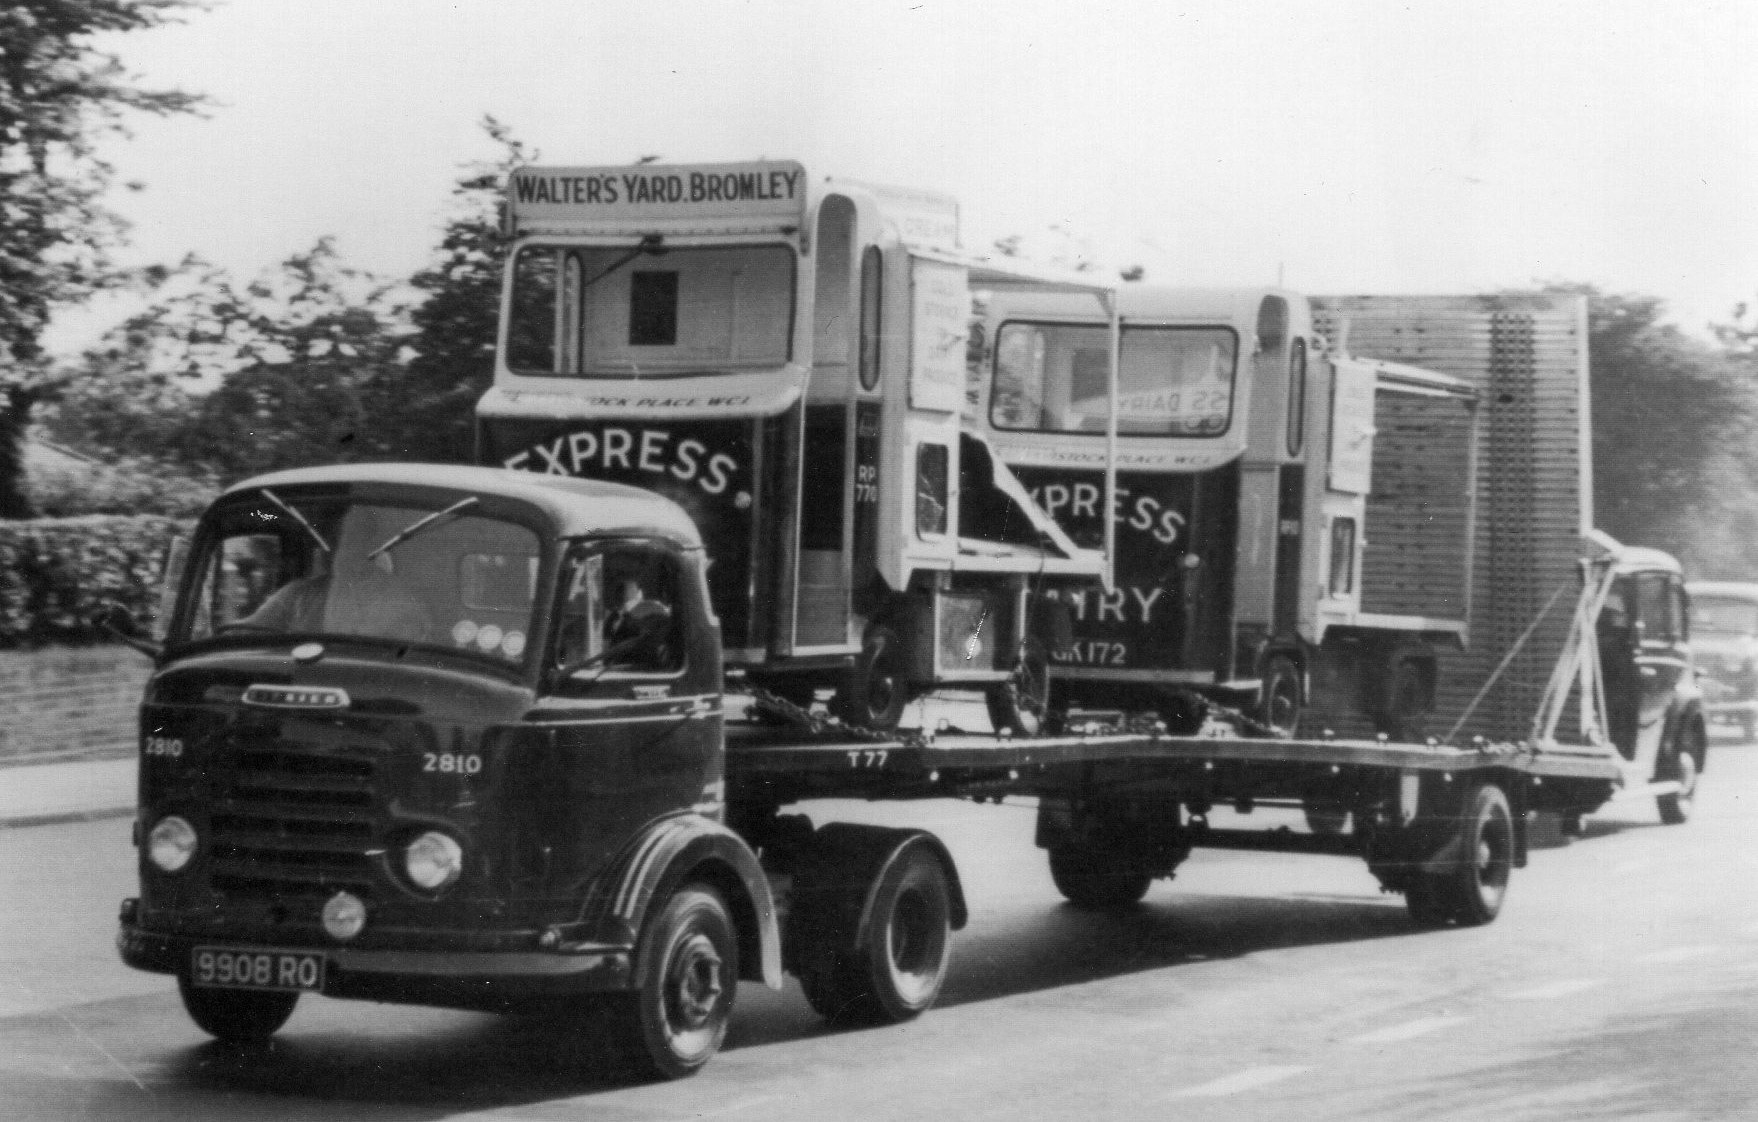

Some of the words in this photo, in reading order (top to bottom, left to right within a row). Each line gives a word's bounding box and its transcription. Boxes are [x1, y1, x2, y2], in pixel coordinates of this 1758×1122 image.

[516, 174, 618, 204] WALTER'S
[1028, 483, 1186, 544] PRESS
[1046, 586, 1163, 623] IRY
[145, 736, 183, 757] 2810
[423, 753, 482, 774] 2810
[199, 952, 271, 984] 9908
[279, 956, 318, 988] RO
